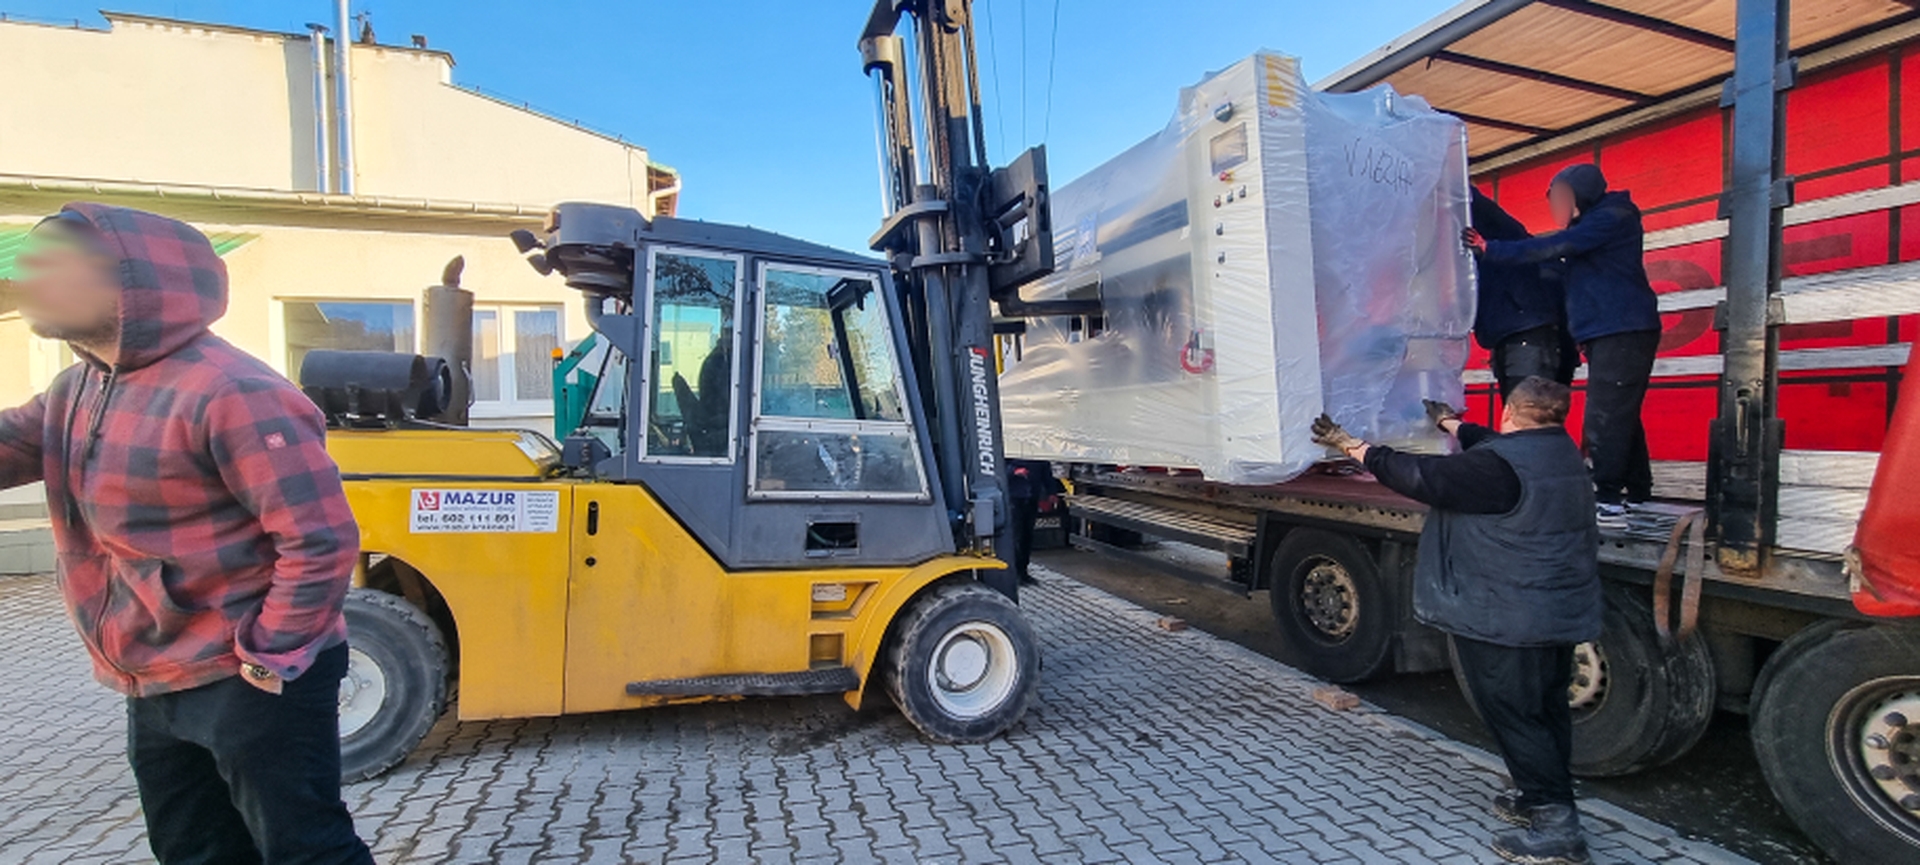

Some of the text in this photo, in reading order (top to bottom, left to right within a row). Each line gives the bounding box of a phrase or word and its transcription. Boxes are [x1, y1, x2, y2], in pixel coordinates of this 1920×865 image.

[968, 346, 995, 476] JUNGHEINRICH
[444, 492, 516, 505] MAZUR
[417, 514, 438, 523] tel.
